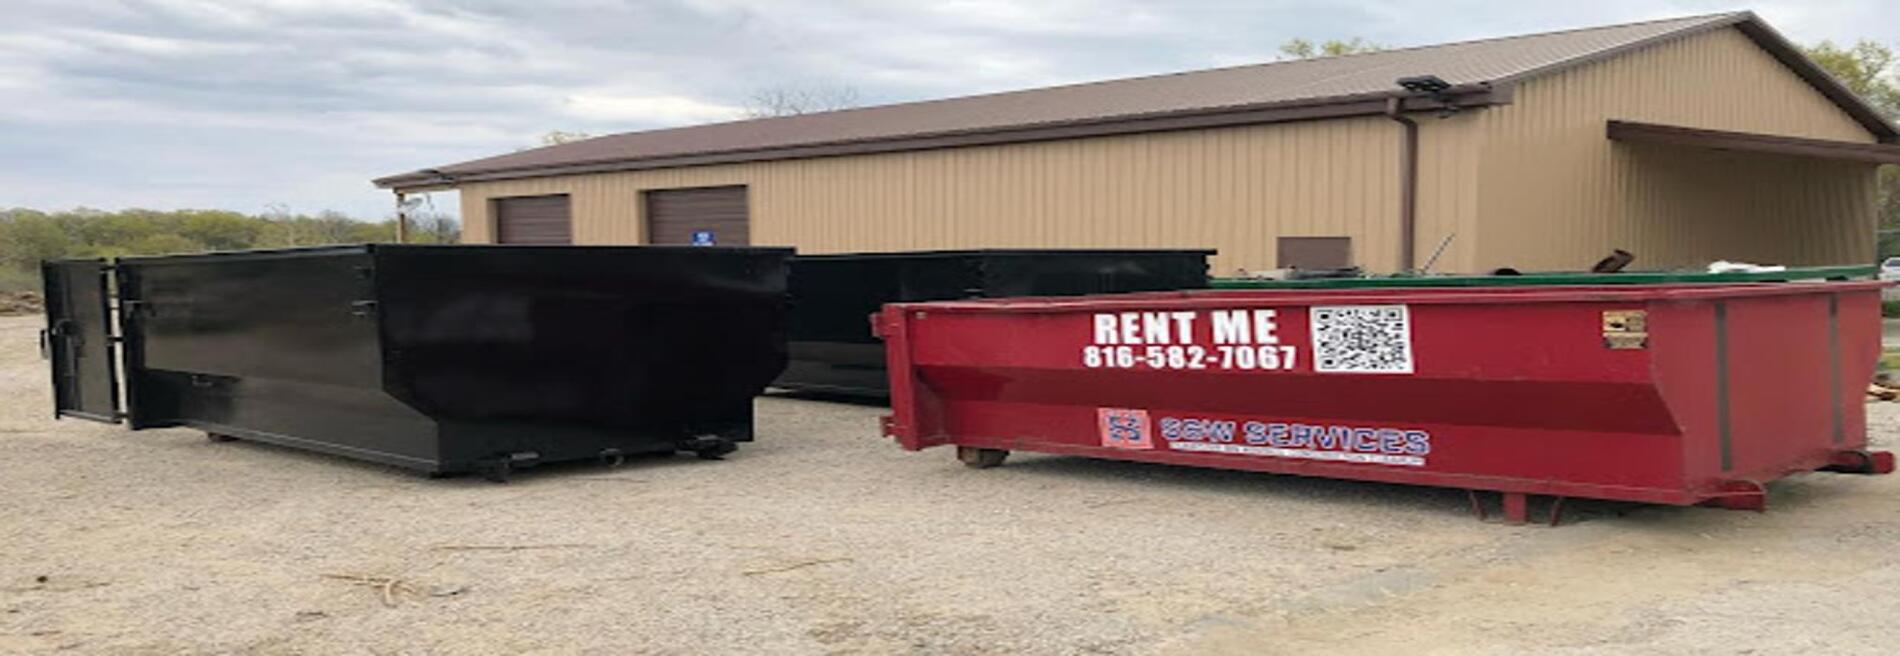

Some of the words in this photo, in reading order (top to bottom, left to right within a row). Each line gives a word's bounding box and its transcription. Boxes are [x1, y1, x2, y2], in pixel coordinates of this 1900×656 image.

[1094, 311, 1196, 345] RENT
[1211, 309, 1278, 345] ME
[1083, 345, 1297, 370] 816-582-7067
[1242, 421, 1430, 456] SERVICES
